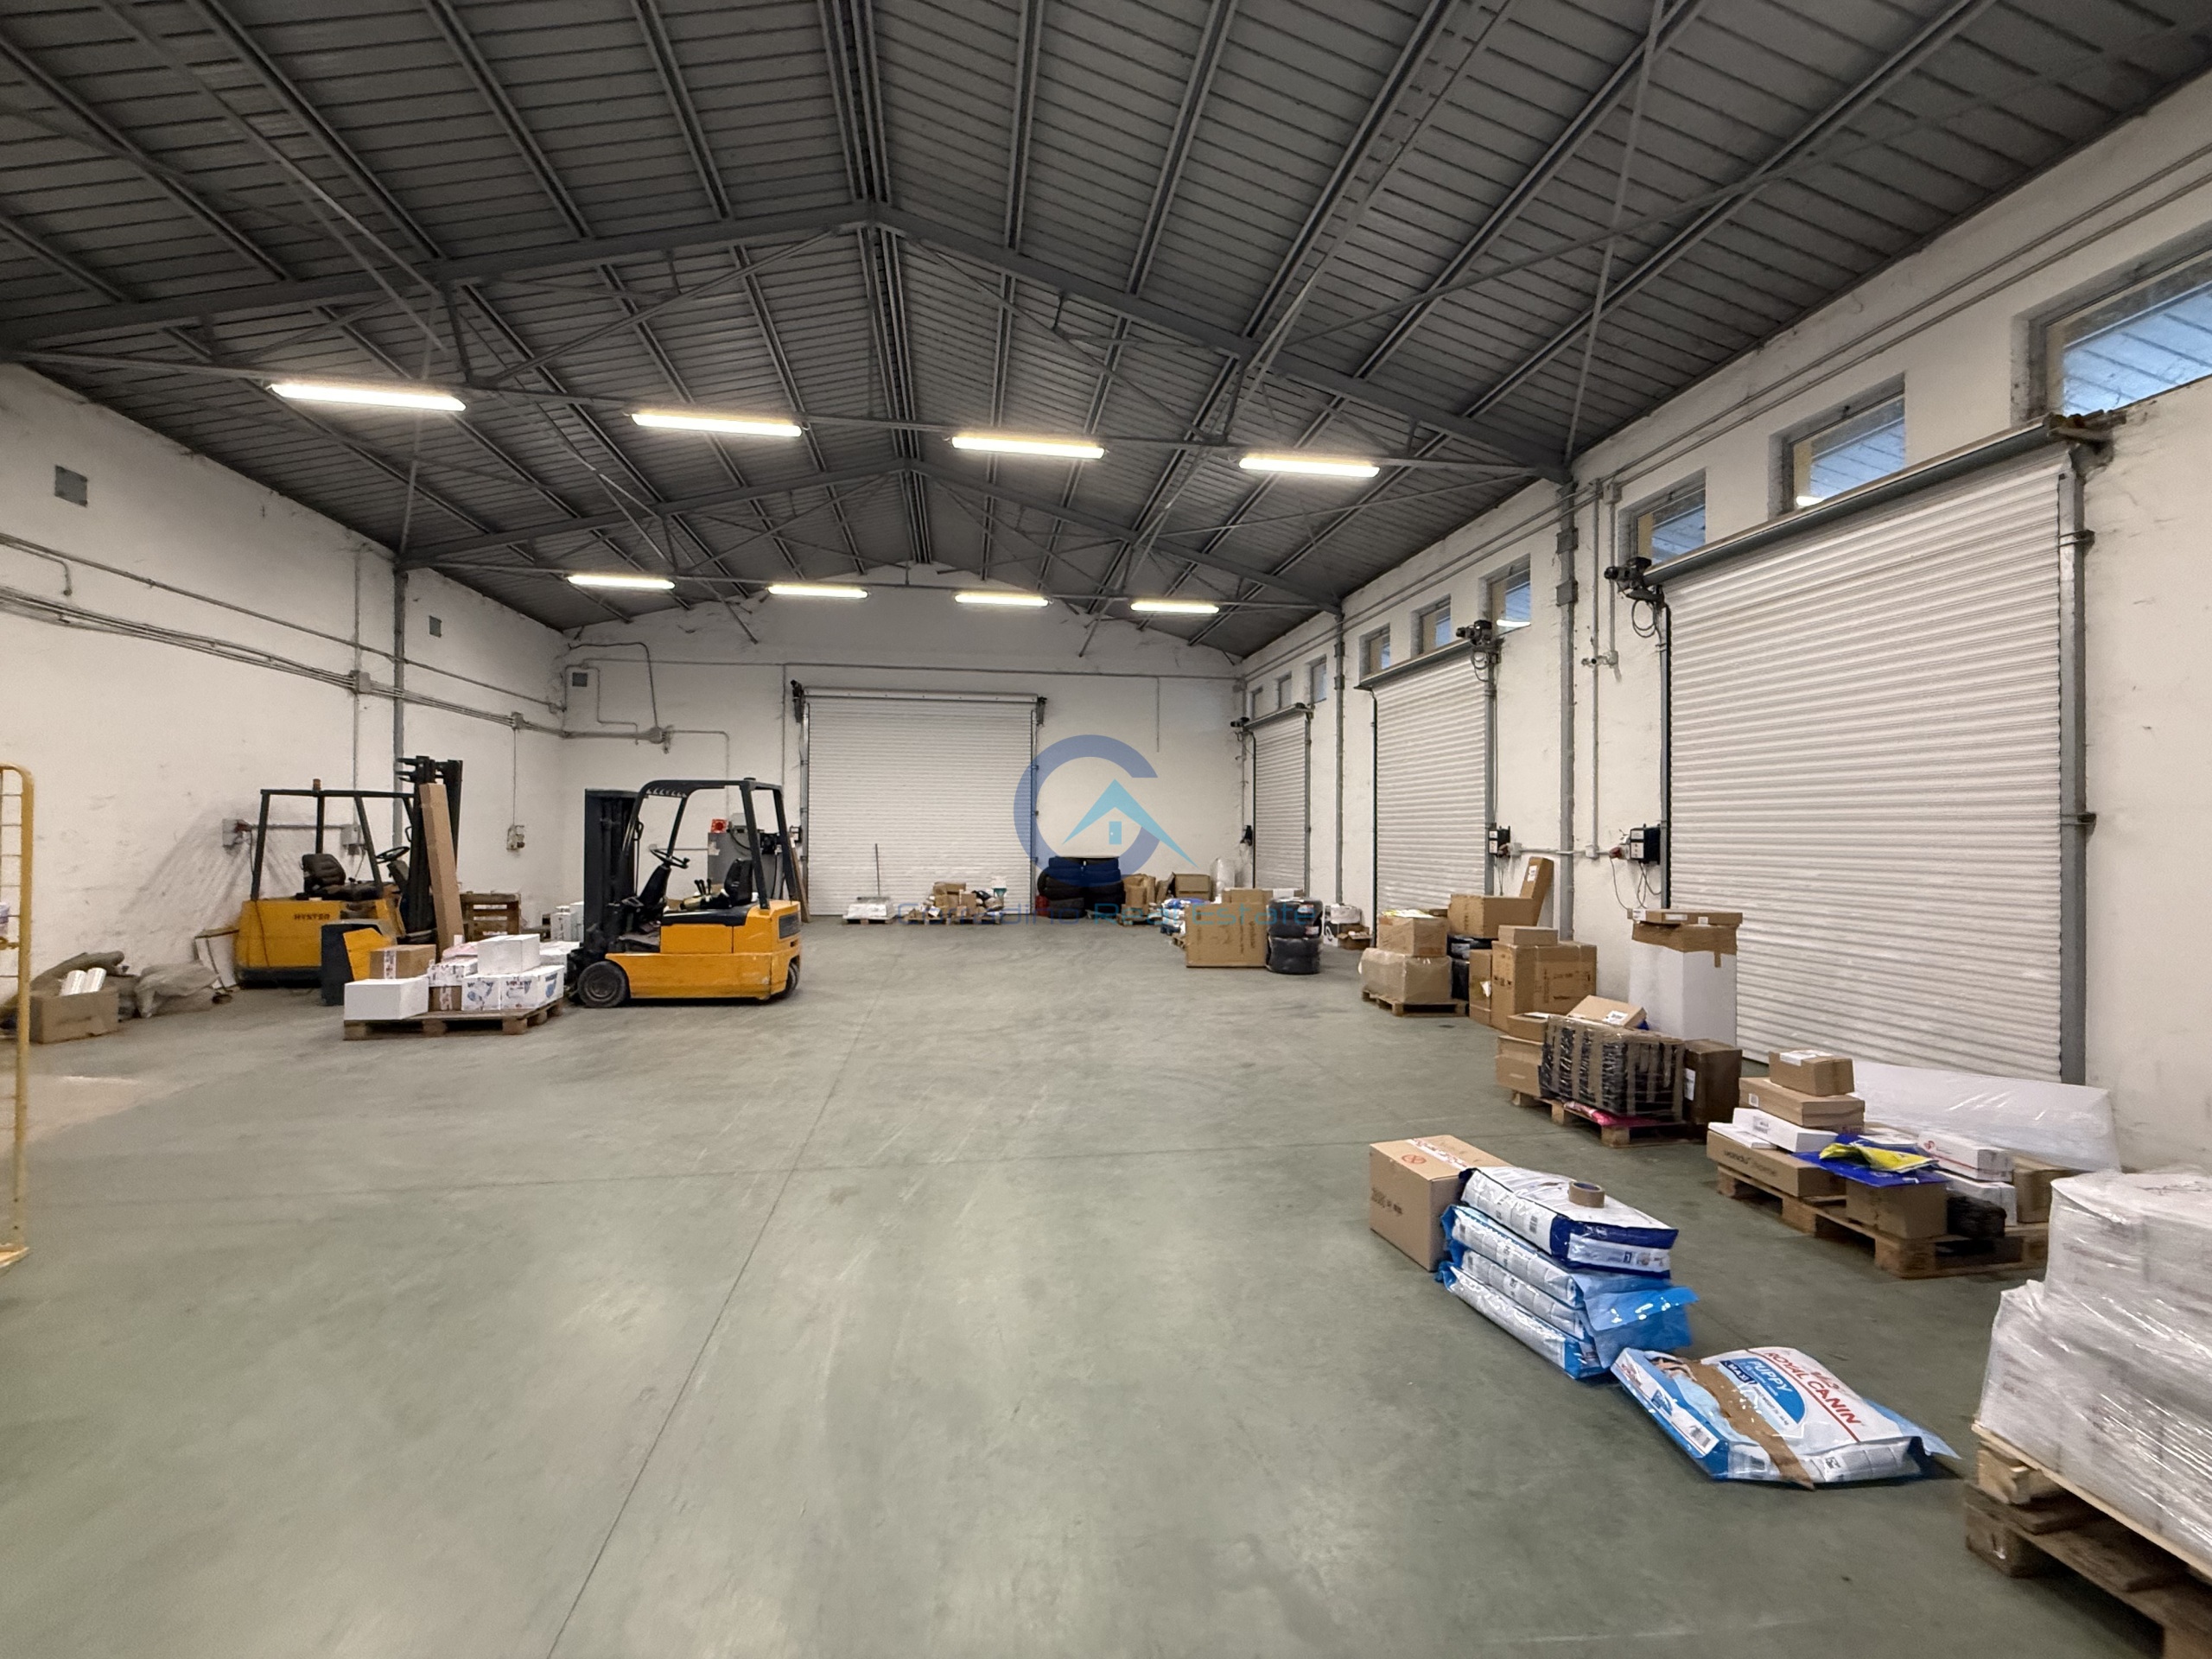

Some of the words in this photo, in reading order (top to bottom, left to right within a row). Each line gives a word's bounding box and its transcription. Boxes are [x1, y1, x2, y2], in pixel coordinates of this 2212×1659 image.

[1747, 1360, 1793, 1392] PUPPY
[1764, 1352, 1808, 1379] ROYAL
[1807, 1381, 1861, 1424] CANIN
